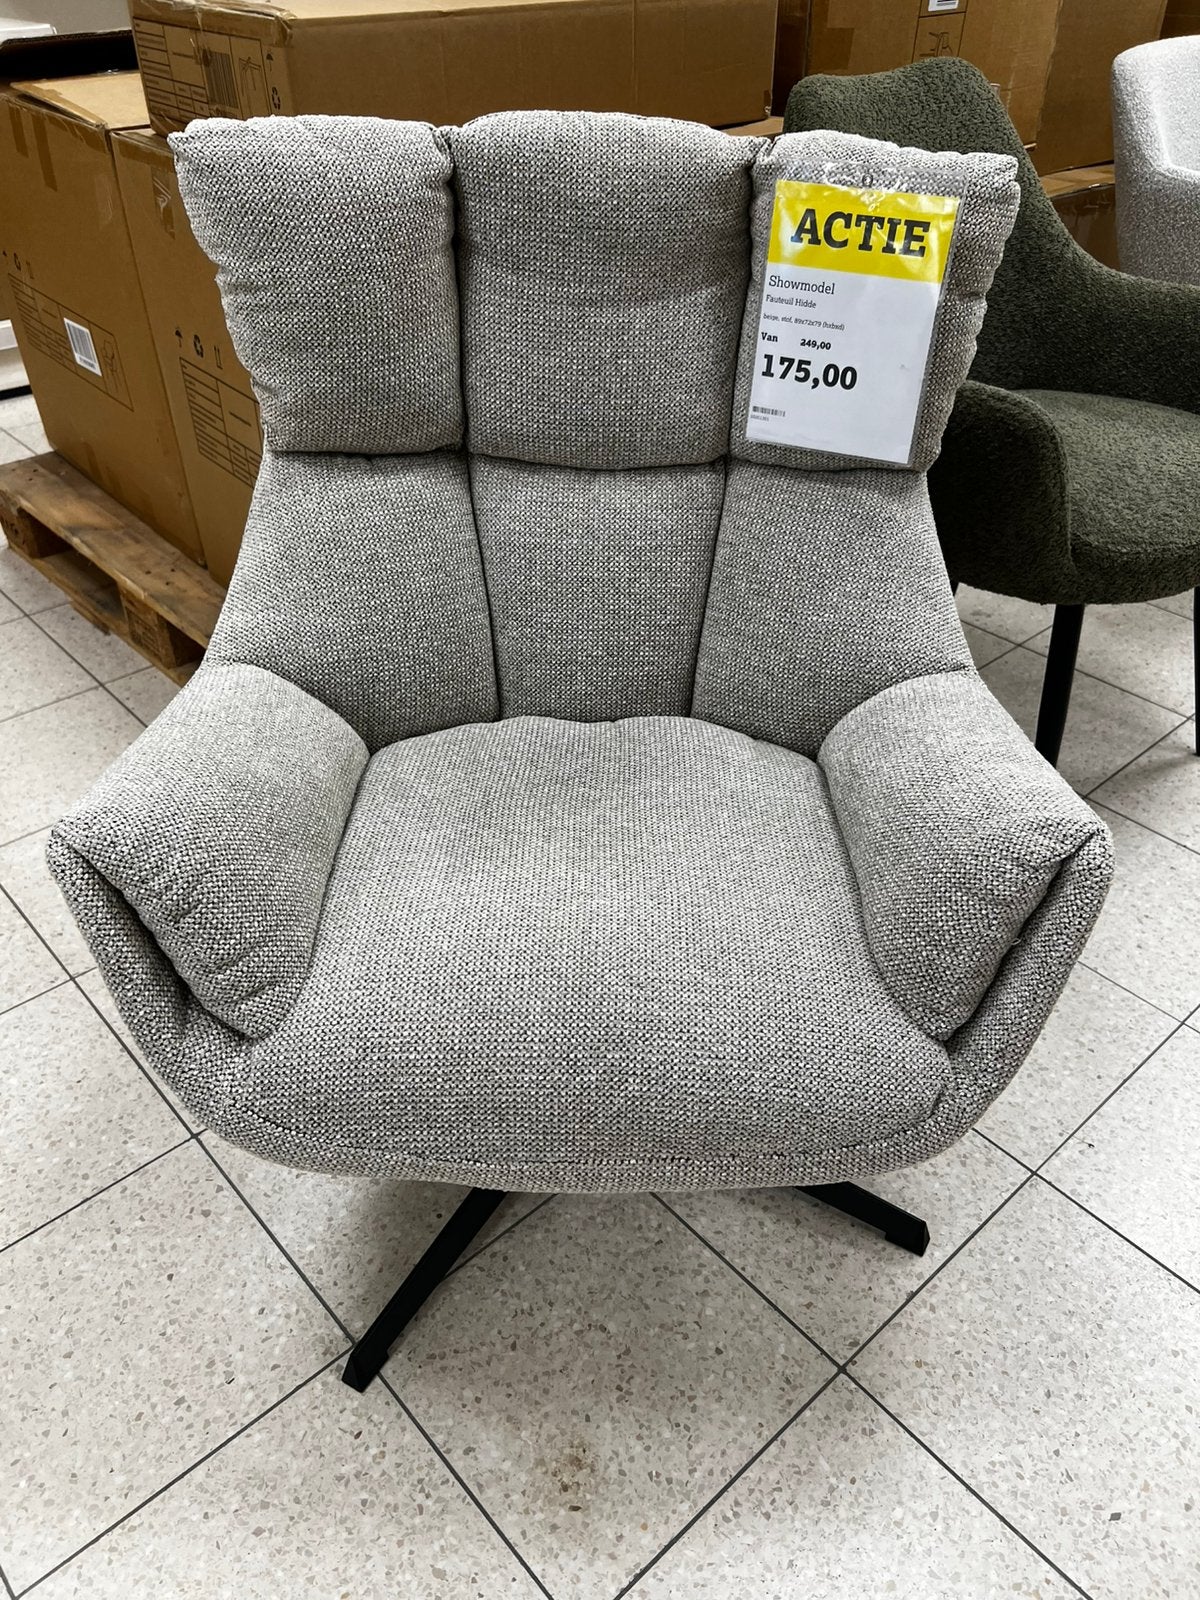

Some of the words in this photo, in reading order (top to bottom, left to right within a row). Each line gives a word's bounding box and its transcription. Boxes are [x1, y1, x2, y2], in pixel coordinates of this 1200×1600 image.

[791, 208, 931, 257] ACTIE
[768, 275, 835, 295] Showmodel
[765, 294, 794, 306] Fauteuil
[795, 298, 817, 309] Hidde
[761, 332, 778, 343] Van
[800, 338, 832, 350] 249,00
[761, 353, 858, 390] 175,00
